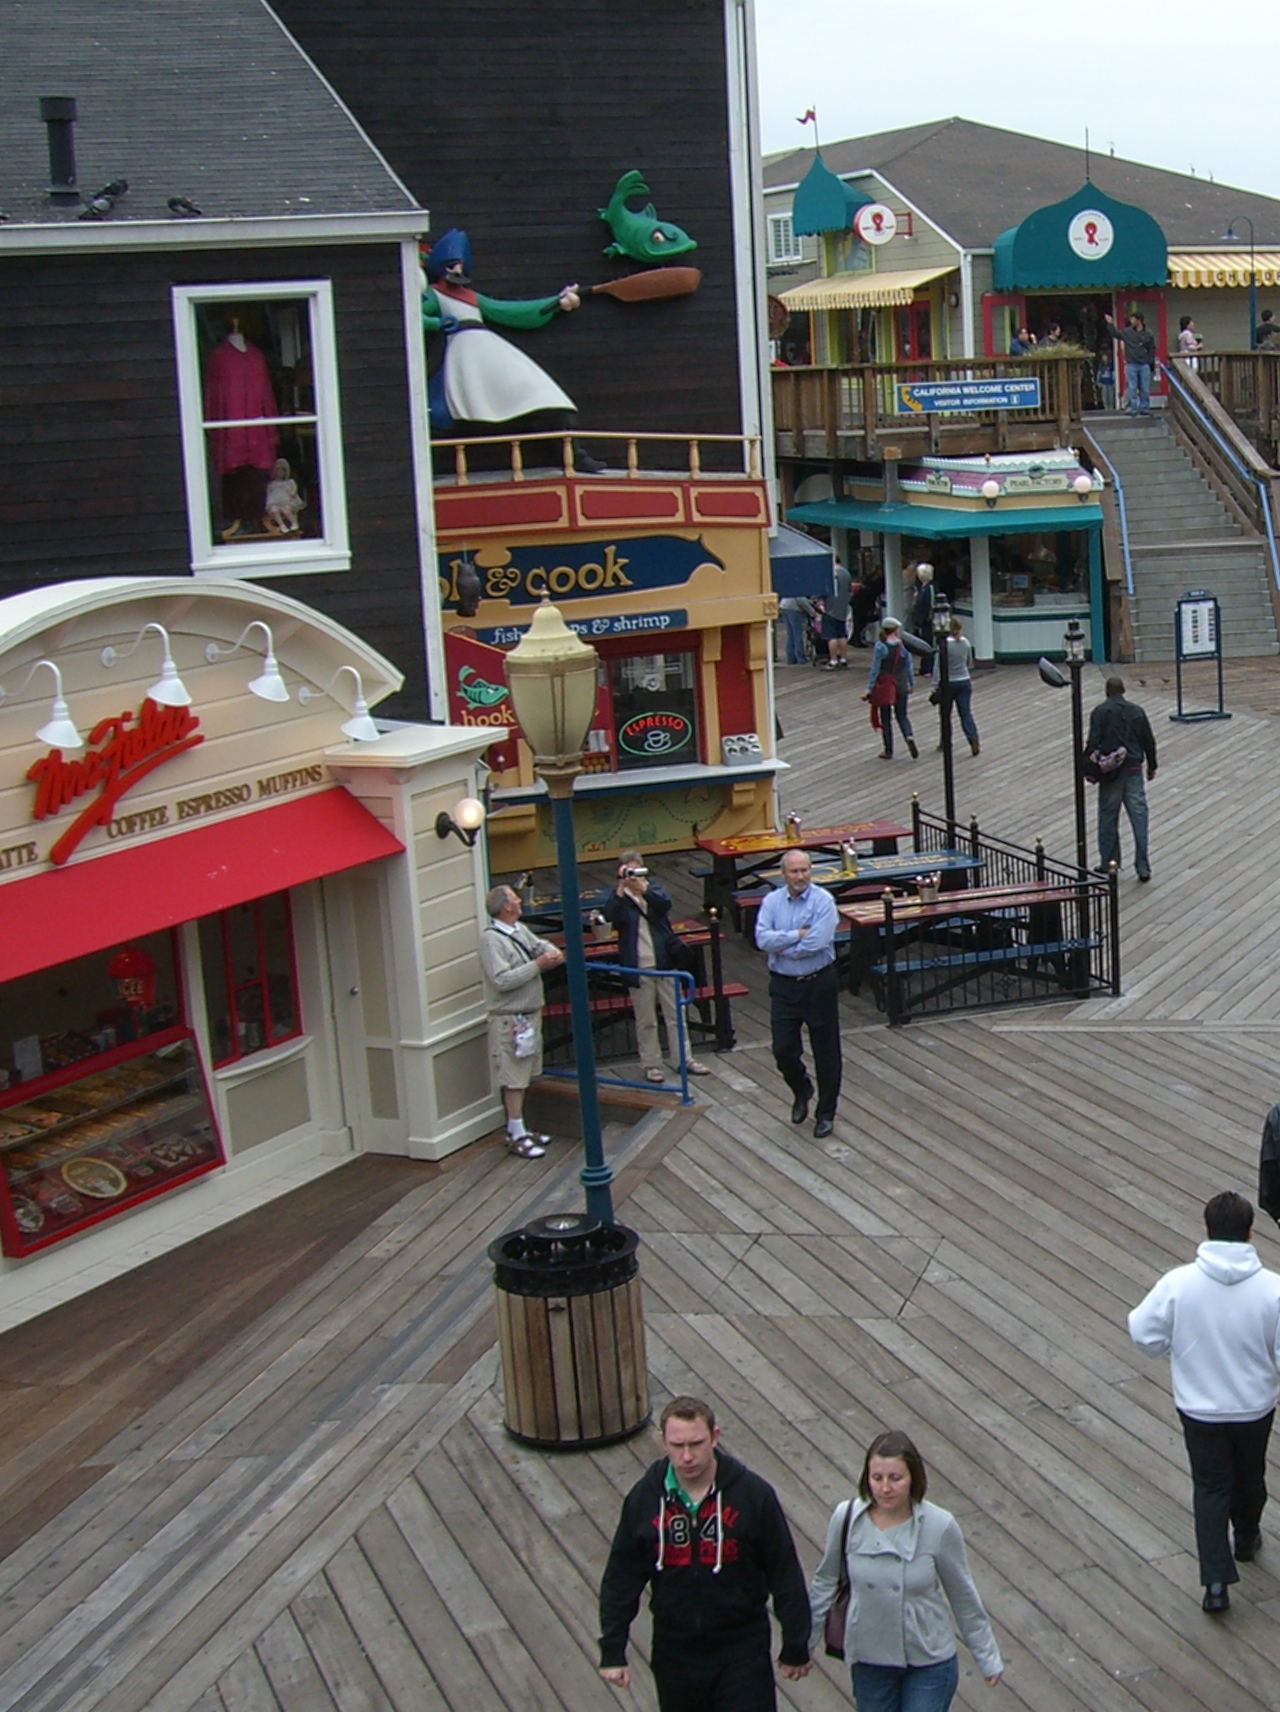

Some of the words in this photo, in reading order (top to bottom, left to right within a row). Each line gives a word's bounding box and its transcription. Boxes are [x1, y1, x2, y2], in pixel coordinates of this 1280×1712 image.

[913, 387, 961, 397] CALIFORNIA
[962, 385, 1003, 395] WELCOME
[1004, 383, 1036, 392] CENTER
[934, 399, 960, 407] VISITOR
[963, 397, 1008, 406] INFORMATION
[1009, 479, 1029, 488] PEARL
[1031, 477, 1063, 487] FACTORY
[485, 567, 521, 597] &
[525, 545, 633, 597] cook
[491, 627, 522, 645] fish
[592, 618, 610, 633] &
[613, 613, 671, 633] shrimp
[461, 706, 516, 727] hook
[625, 715, 684, 736] ESPRESSO
[107, 806, 169, 838] COFFEE
[177, 783, 251, 821] ESPRESSO
[257, 764, 323, 798] MUFFINS
